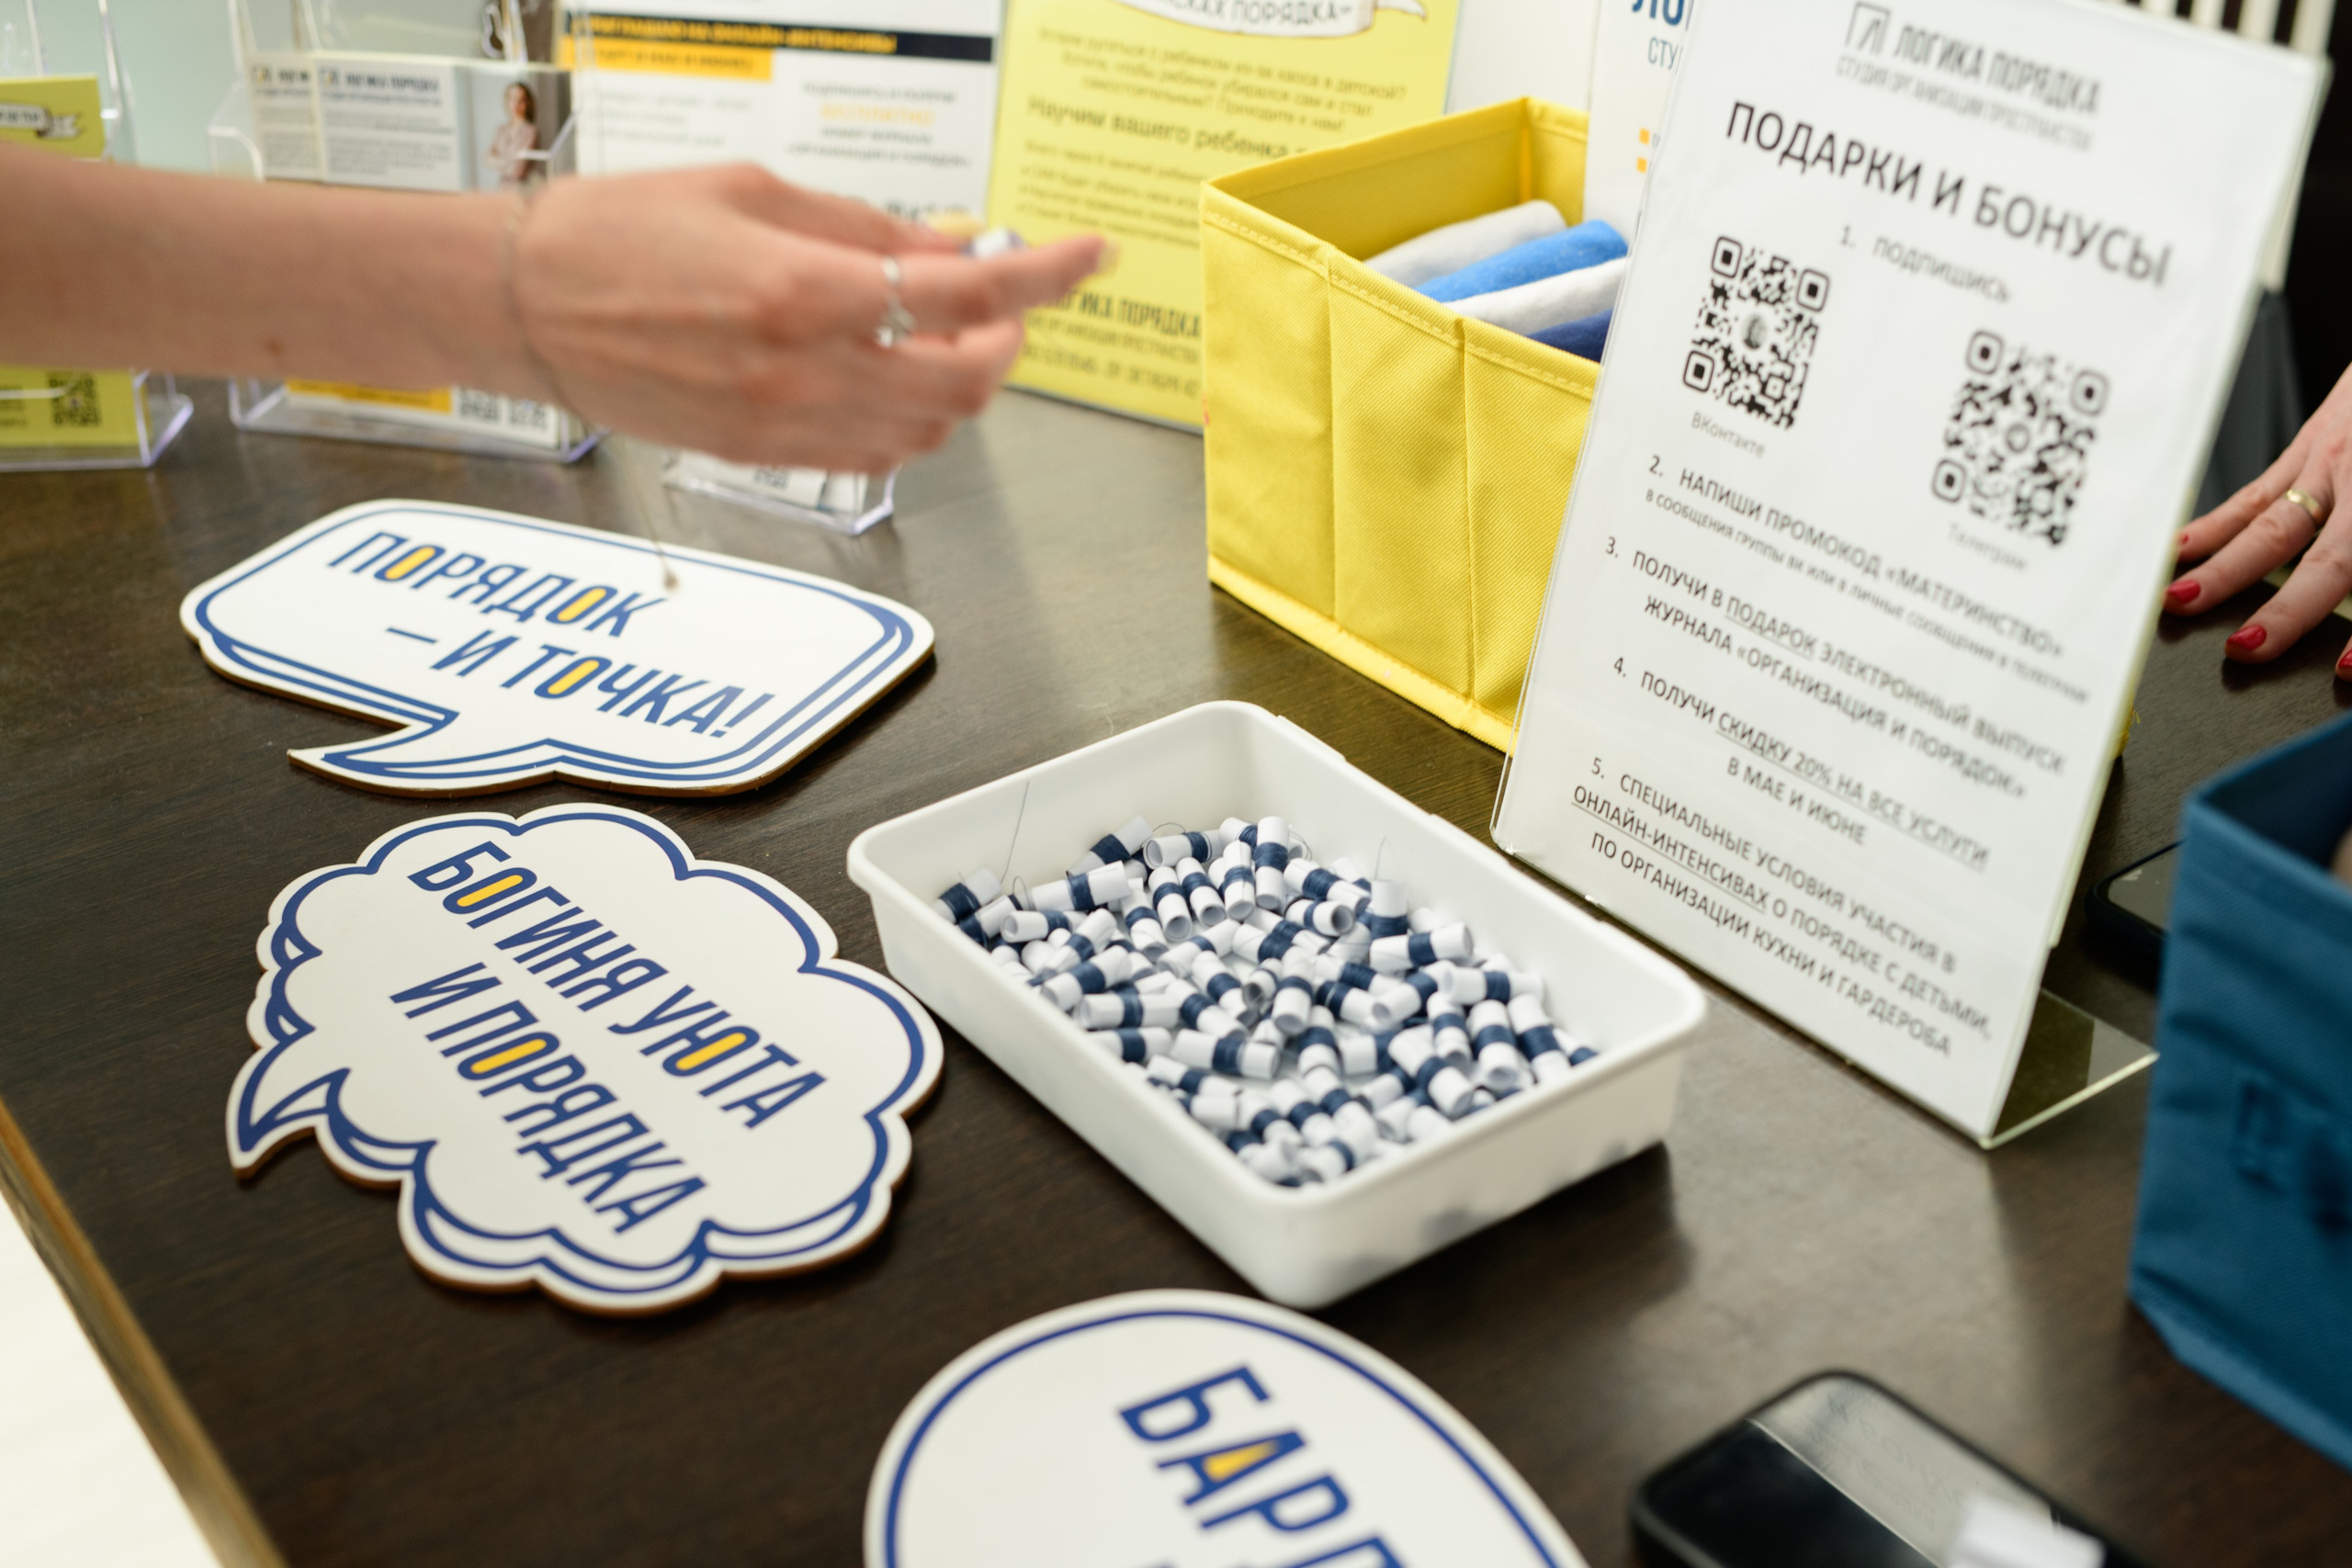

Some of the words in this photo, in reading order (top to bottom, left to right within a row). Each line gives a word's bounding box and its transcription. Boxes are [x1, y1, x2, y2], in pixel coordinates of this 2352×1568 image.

[1894, 24, 1984, 81] ЛОГИКА
[1986, 51, 2102, 114] ПОРЯДКА
[1725, 101, 1923, 202] ПОДАРКИ
[1931, 169, 1965, 217] И
[1974, 184, 2173, 288] БОНУСЫ
[1647, 454, 1664, 478] 2.
[1679, 467, 1764, 523] НАПИШИ
[1764, 508, 1883, 580] ПРОМОКОД
[1690, 412, 1767, 459] ВКонтакте
[327, 531, 670, 638] ПОРЯДОК
[1605, 536, 1619, 558] 3.
[1632, 549, 1710, 602] ПОЛУЧИ
[1711, 587, 1724, 609] В
[1725, 595, 1819, 654] ПОДАРОК
[1818, 641, 1972, 731] ЭЛЕКТРОННЫЙ
[1972, 716, 2067, 775] ВЫПУСК
[1644, 593, 1734, 655] ЖУРНАЛА
[1736, 646, 1888, 732] «ОРГАНИЗАЦИЯ
[1889, 716, 1908, 743] И
[428, 629, 523, 678] И
[499, 642, 777, 739] ТОЧКА!
[1612, 656, 1628, 679] 4.
[1640, 670, 1716, 724] ПОЛУЧИ
[1717, 711, 1792, 764] СКИДКУ
[1793, 750, 1835, 788] 20%
[1837, 772, 1865, 802] НА
[1867, 789, 1905, 827] ВСЕ
[1908, 810, 1991, 866] УСЛУГИ
[1572, 784, 1770, 911] ОНЛАЙН-ИНТЕНСИВАХ
[1771, 897, 1789, 919] О
[1790, 908, 1882, 975] ПОРЯДКЕ
[1883, 961, 1901, 985] С
[1590, 756, 1606, 780] 5.
[1619, 773, 1753, 861] СПЕЦИАЛЬНЫЕ
[1754, 847, 1846, 913] УСЛОВИЯ
[1849, 897, 1940, 964] УЧАСТИЯ
[1726, 756, 1740, 777] В
[1742, 765, 1786, 802] МАЕ
[1788, 789, 1804, 812] И
[1806, 799, 1868, 847] ИЮНЕ
[389, 961, 503, 1020] И
[406, 840, 671, 1012] БОГИНЯ
[605, 984, 828, 1130] УЮТА
[1590, 831, 1618, 859] ПО
[1620, 850, 1750, 939] ОРГАНИЗАЦИИ
[1751, 925, 1816, 978] КУХНИ
[1817, 964, 1837, 988] И
[1836, 975, 1952, 1056] ГАРДЕРОБА
[424, 999, 708, 1235] ПОРЯДКА
[1118, 1365, 1404, 1568] БАР
